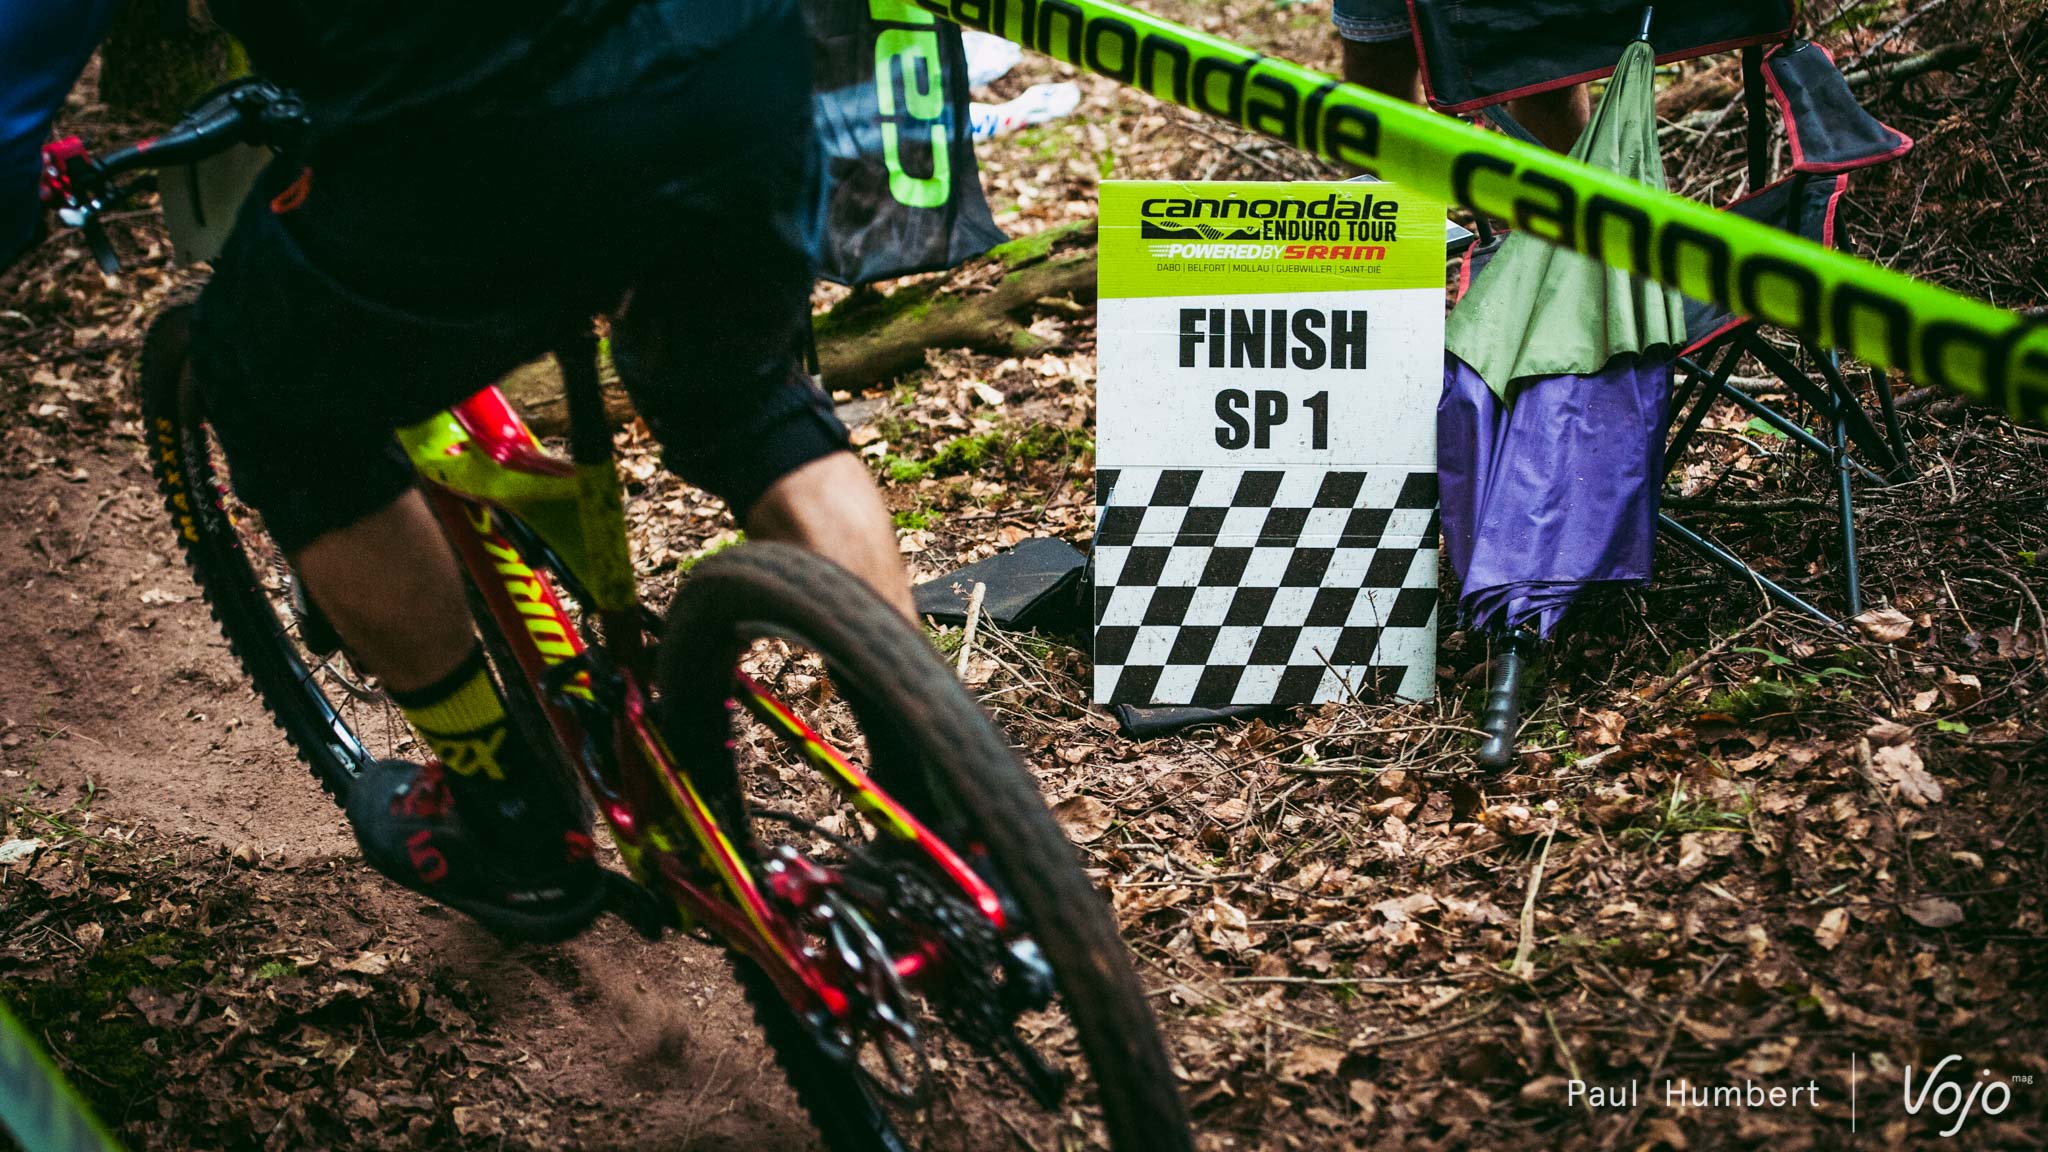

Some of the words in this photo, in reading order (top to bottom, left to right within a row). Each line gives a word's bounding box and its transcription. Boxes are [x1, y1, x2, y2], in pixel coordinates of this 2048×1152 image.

[1141, 194, 1399, 220] cannondale
[1263, 220, 1340, 242] ENDURO
[1347, 221, 1398, 242] TOUR
[1284, 245, 1387, 261] SRAM
[1157, 263, 1181, 272] DABO
[1188, 263, 1225, 272] BELFORT
[1232, 264, 1270, 273] MOLLAU
[1276, 264, 1332, 273] GUEBWILLER
[1179, 308, 1368, 370] FINISH
[1215, 388, 1288, 450] SP
[1302, 390, 1329, 450] 1
